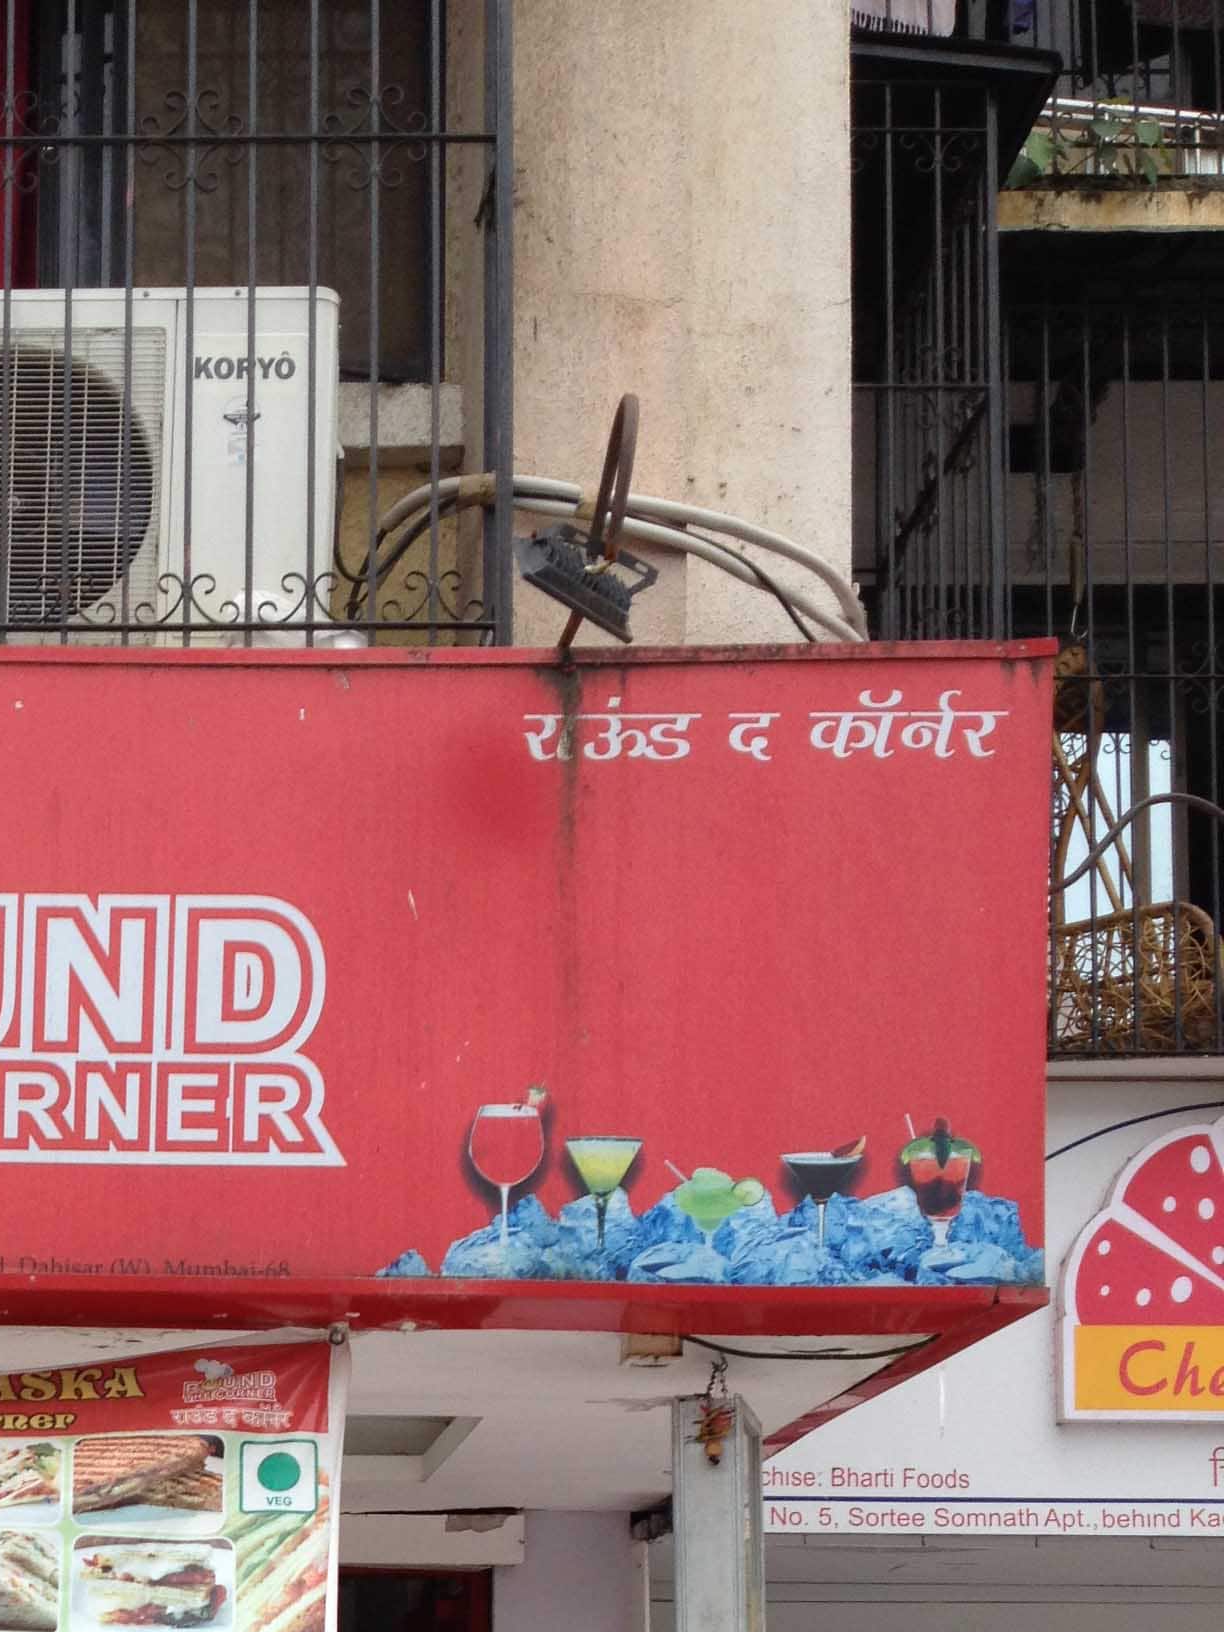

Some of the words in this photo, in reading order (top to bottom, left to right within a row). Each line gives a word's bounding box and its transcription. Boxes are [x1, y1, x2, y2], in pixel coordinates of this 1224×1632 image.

[728, 712, 780, 762] द
[809, 689, 1008, 759] कॉर्नर
[831, 1467, 894, 1489] Bharti
[902, 1467, 970, 1489] Foods
[265, 1495, 293, 1507] VEG
[770, 1506, 809, 1527] No.
[818, 1507, 839, 1529] 5,
[848, 1507, 926, 1528] Sortee
[933, 1507, 1039, 1528] Somnath
[1102, 1508, 1181, 1529] behind
